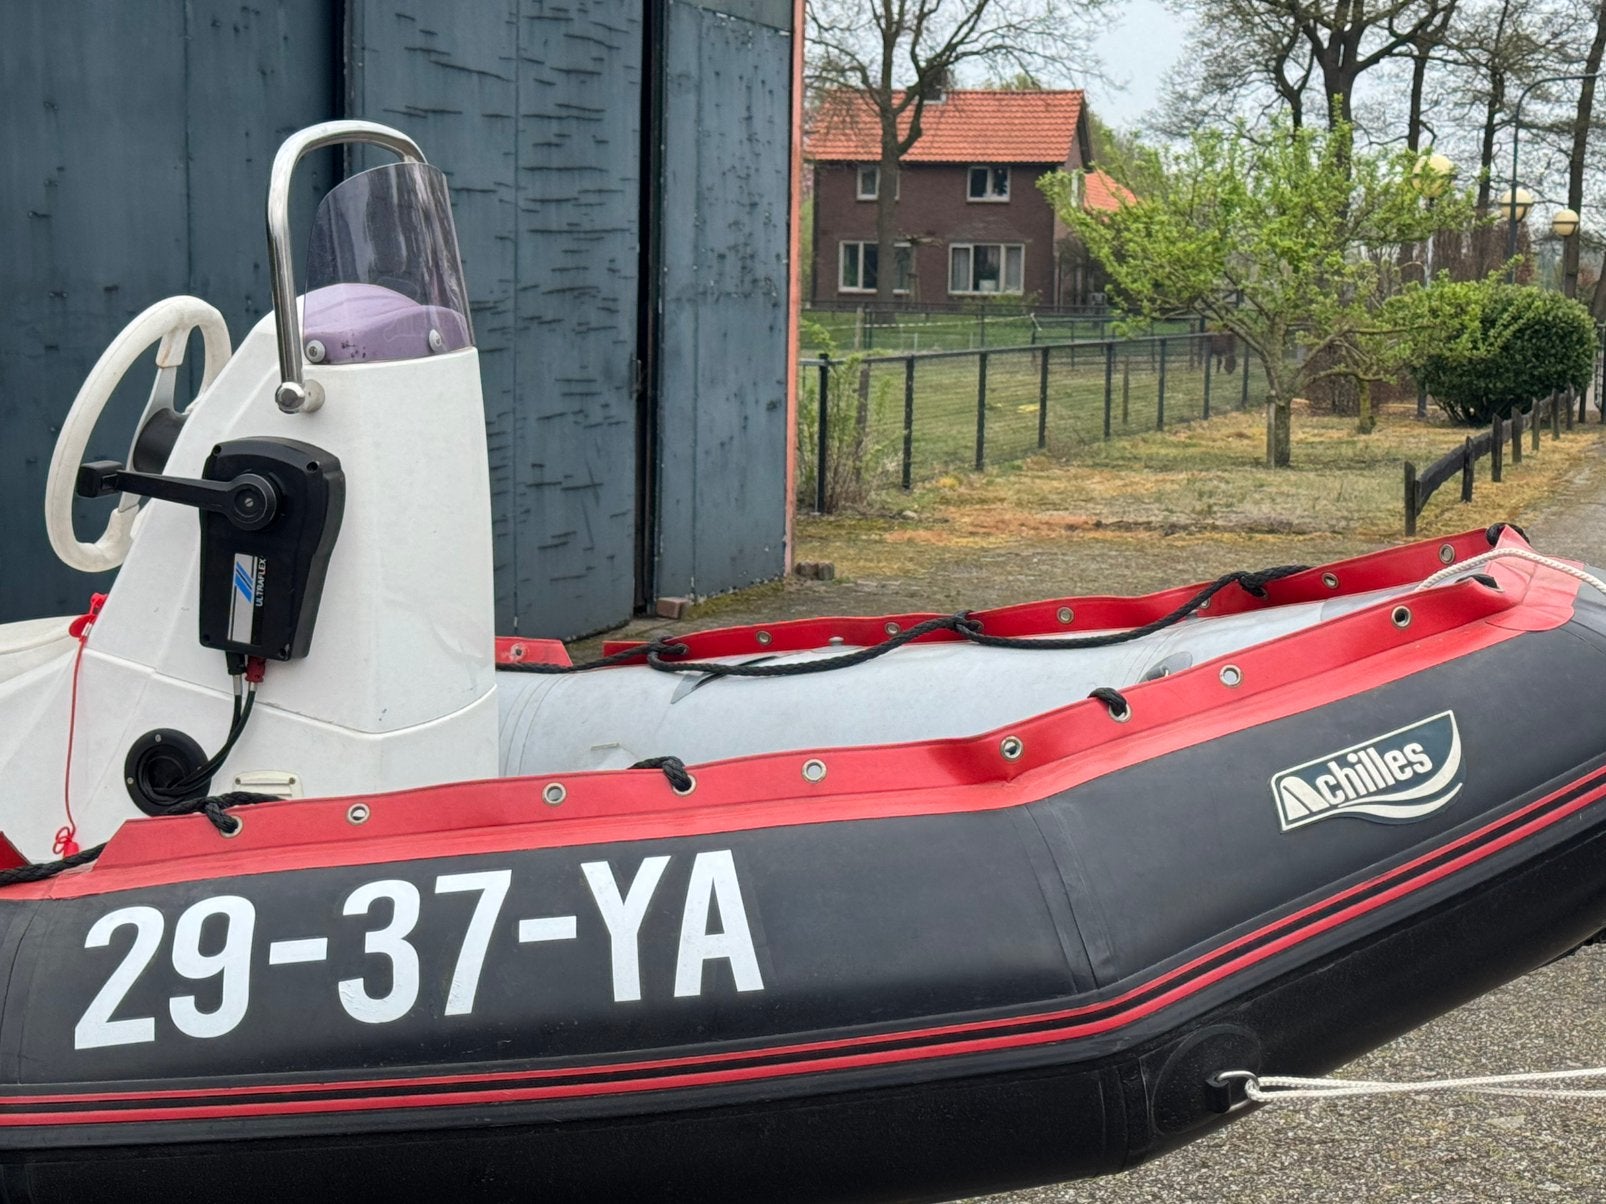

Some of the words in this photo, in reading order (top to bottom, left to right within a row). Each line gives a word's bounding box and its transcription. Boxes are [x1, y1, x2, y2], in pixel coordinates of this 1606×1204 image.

[256, 558, 267, 607] ULTRAFLEX
[1280, 742, 1433, 821] Achilles
[74, 849, 765, 1050] 29-37-YA
